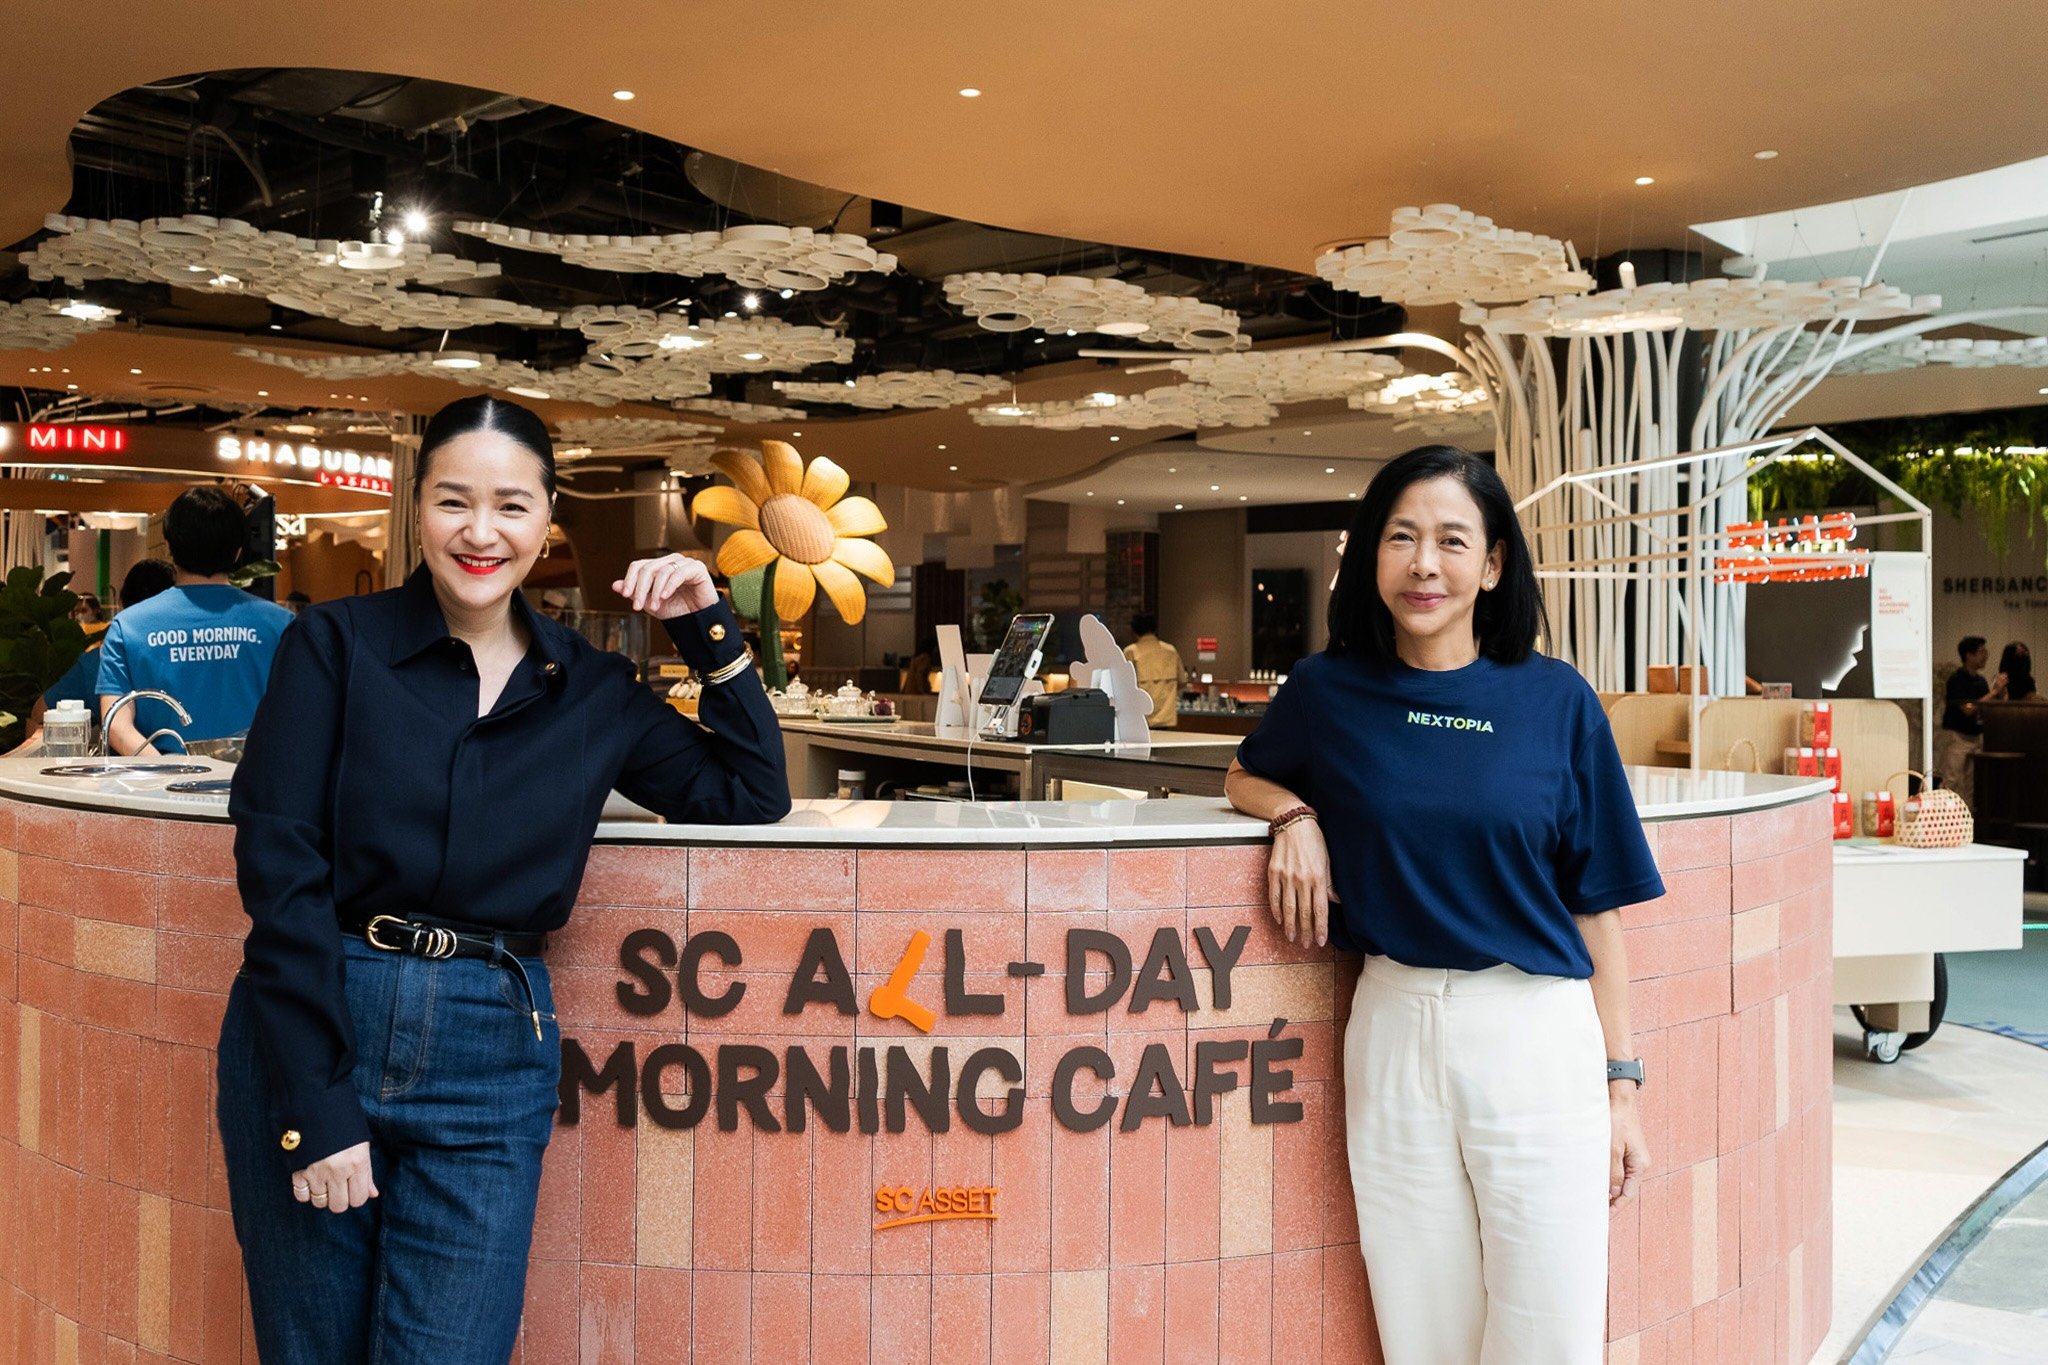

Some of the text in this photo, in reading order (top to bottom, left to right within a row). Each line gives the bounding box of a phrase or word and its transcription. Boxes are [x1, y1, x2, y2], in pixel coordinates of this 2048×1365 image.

[30, 427, 121, 449] MINI
[147, 626, 262, 647] GOOD MORNING.
[170, 644, 240, 662] EVERYDAY
[1407, 711, 1494, 733] NEXTOPIA
[615, 928, 747, 1018] SC
[559, 1018, 1304, 1134] MORNING CAFÉ
[876, 1186, 998, 1214] SC ASSET
